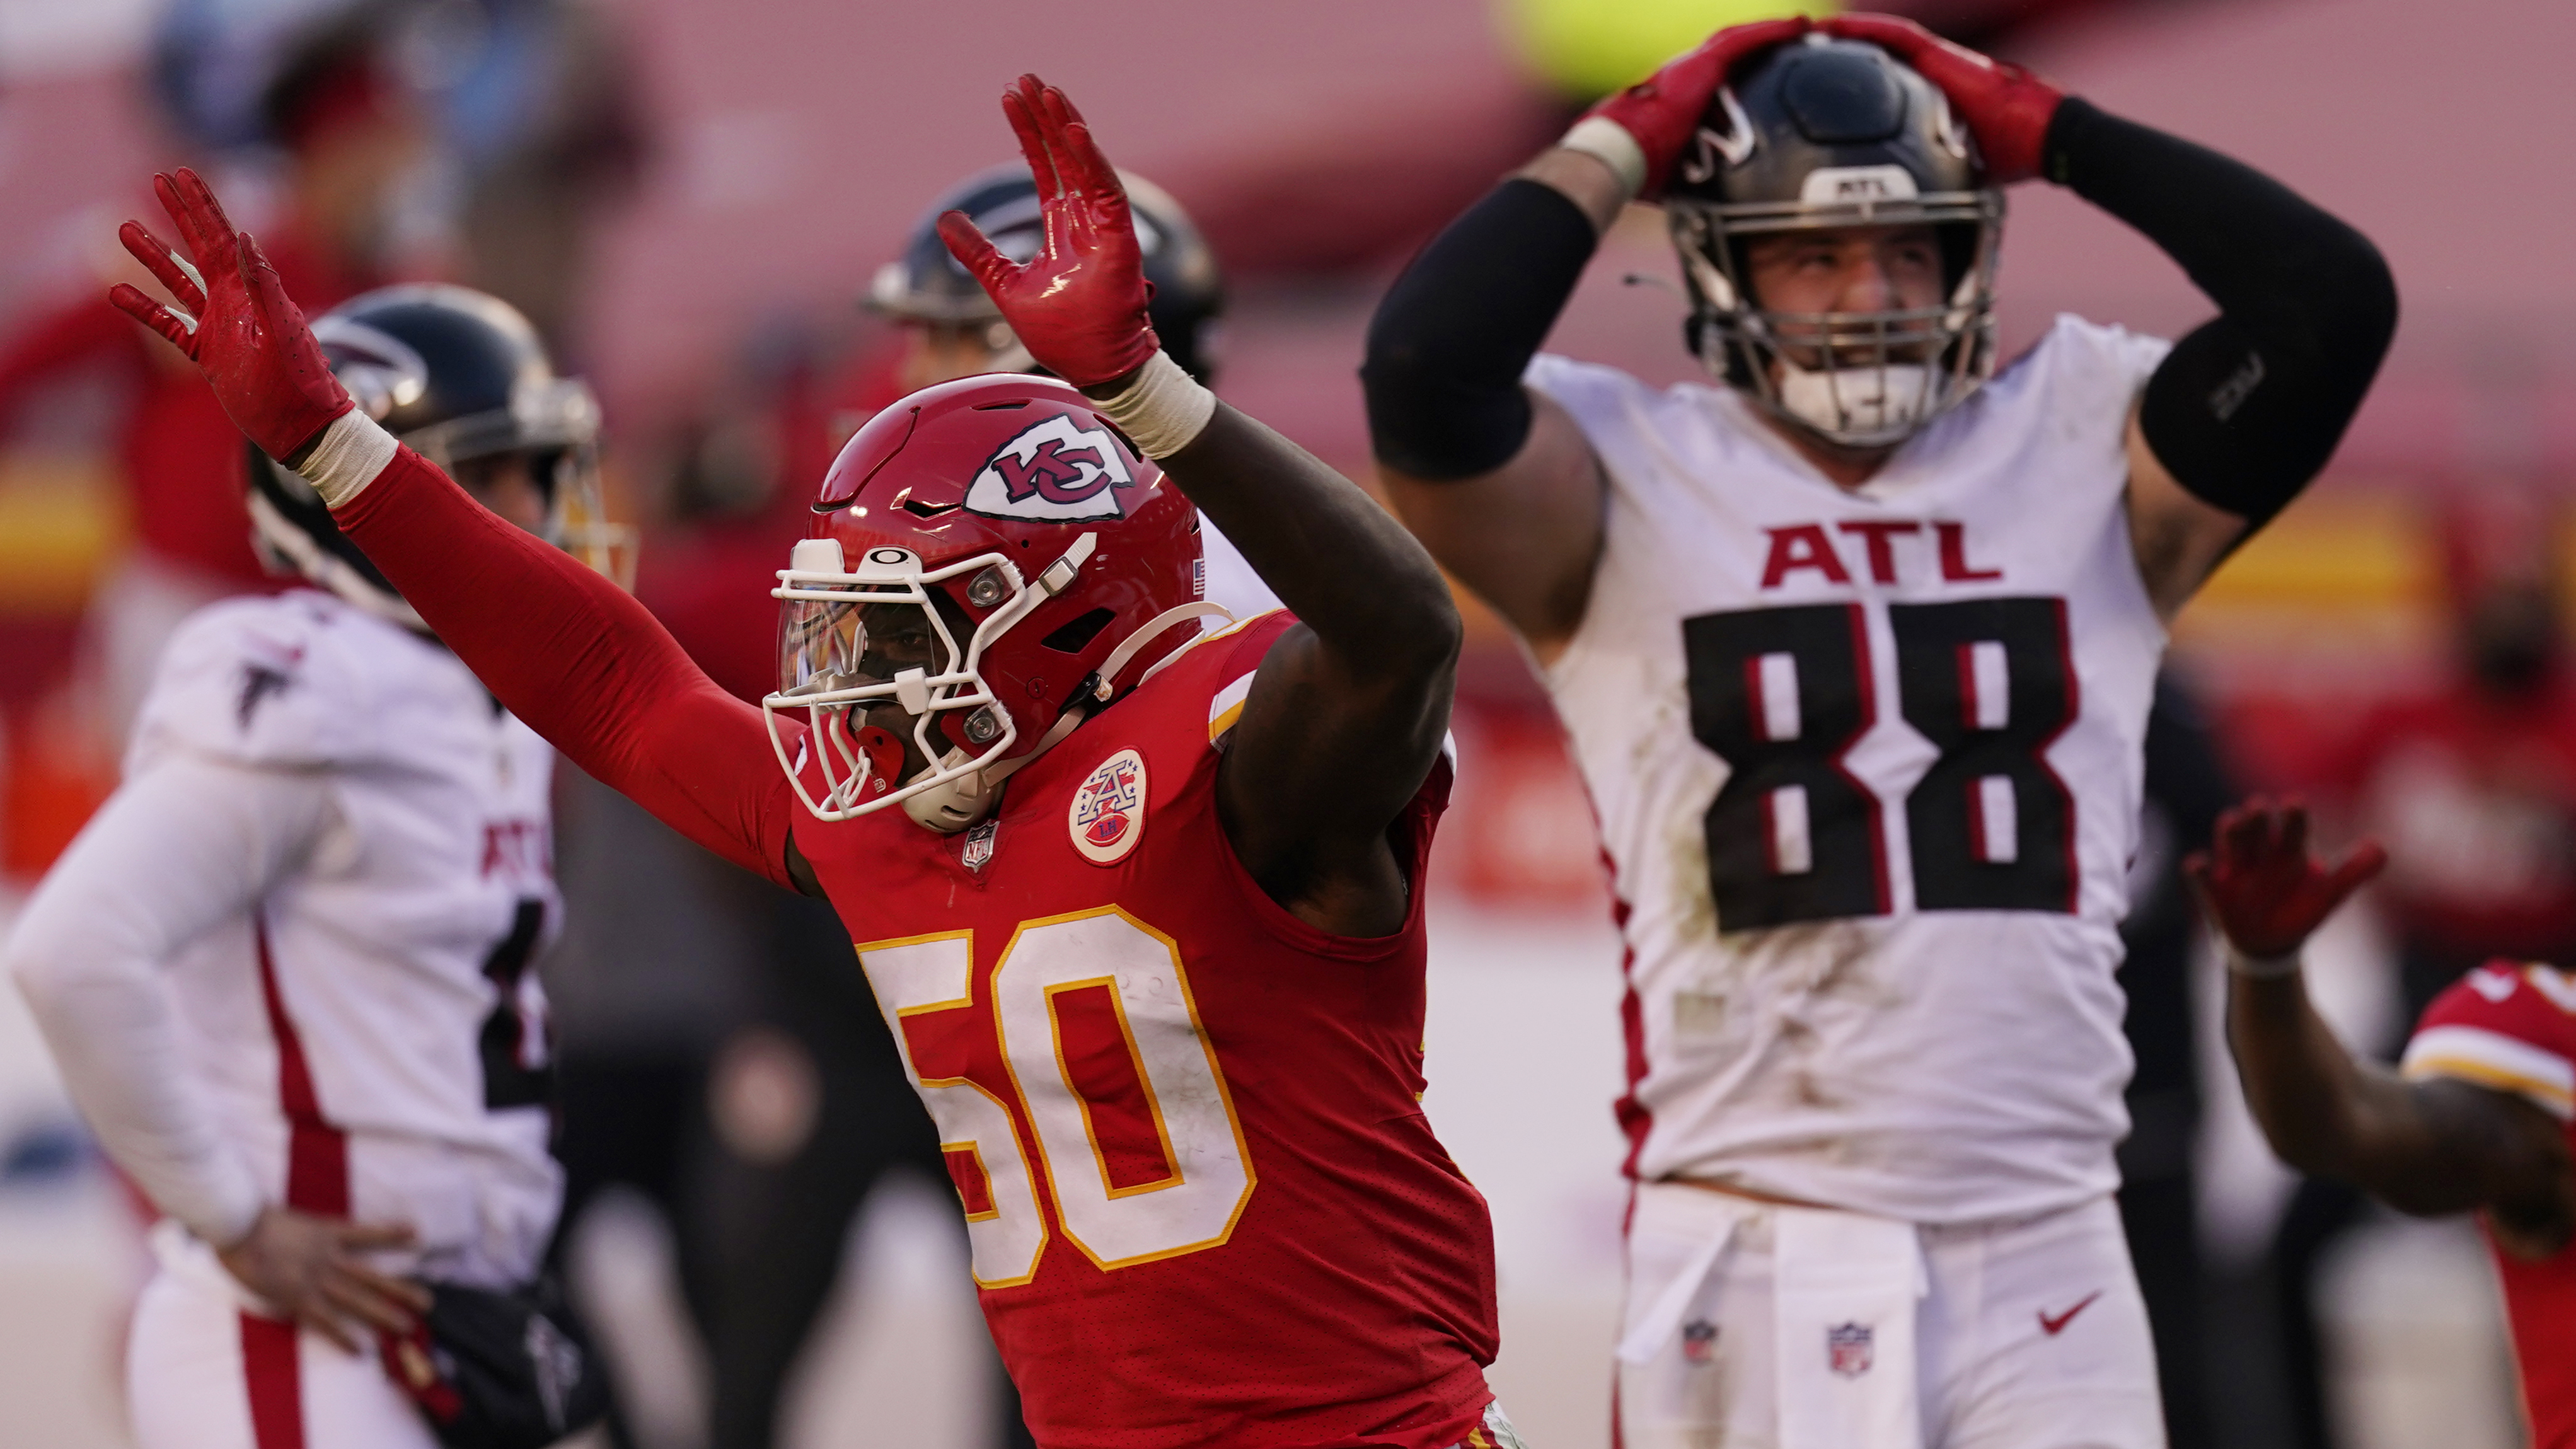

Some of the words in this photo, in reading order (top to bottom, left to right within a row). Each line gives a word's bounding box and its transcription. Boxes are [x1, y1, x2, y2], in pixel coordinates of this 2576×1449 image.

[991, 437, 1112, 504] KC
[1760, 519, 2002, 590] ATL
[1078, 759, 1136, 826] A
[1682, 596, 2080, 935] 88
[965, 840, 987, 862] NFL
[1099, 820, 1118, 838] LH
[853, 904, 1257, 1289] 50
